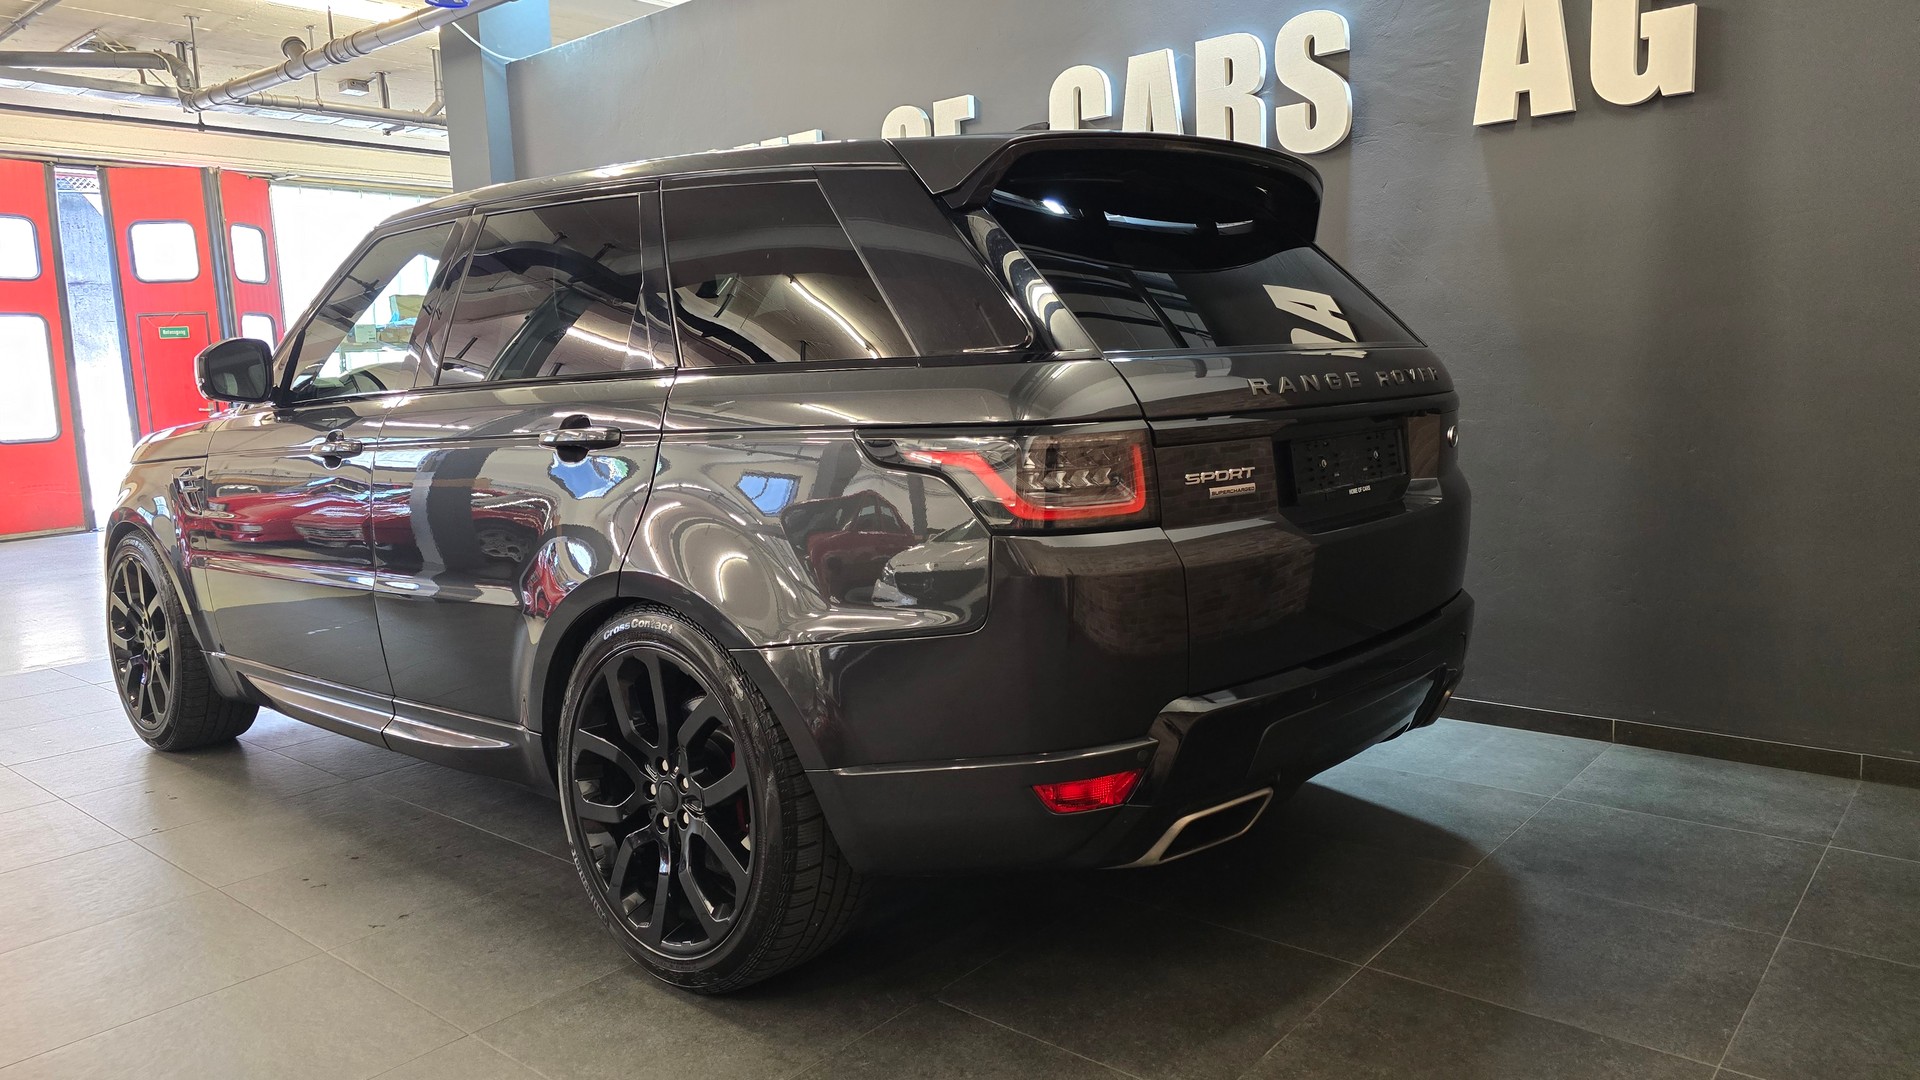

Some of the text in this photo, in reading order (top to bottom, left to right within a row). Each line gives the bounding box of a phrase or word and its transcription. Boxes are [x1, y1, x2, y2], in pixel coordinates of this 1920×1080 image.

[1049, 0, 1697, 154] CARS AG
[1247, 366, 1438, 396] RANGE ROVER
[1185, 466, 1256, 485] SPORT
[1211, 486, 1255, 496] SUPERCHARGED
